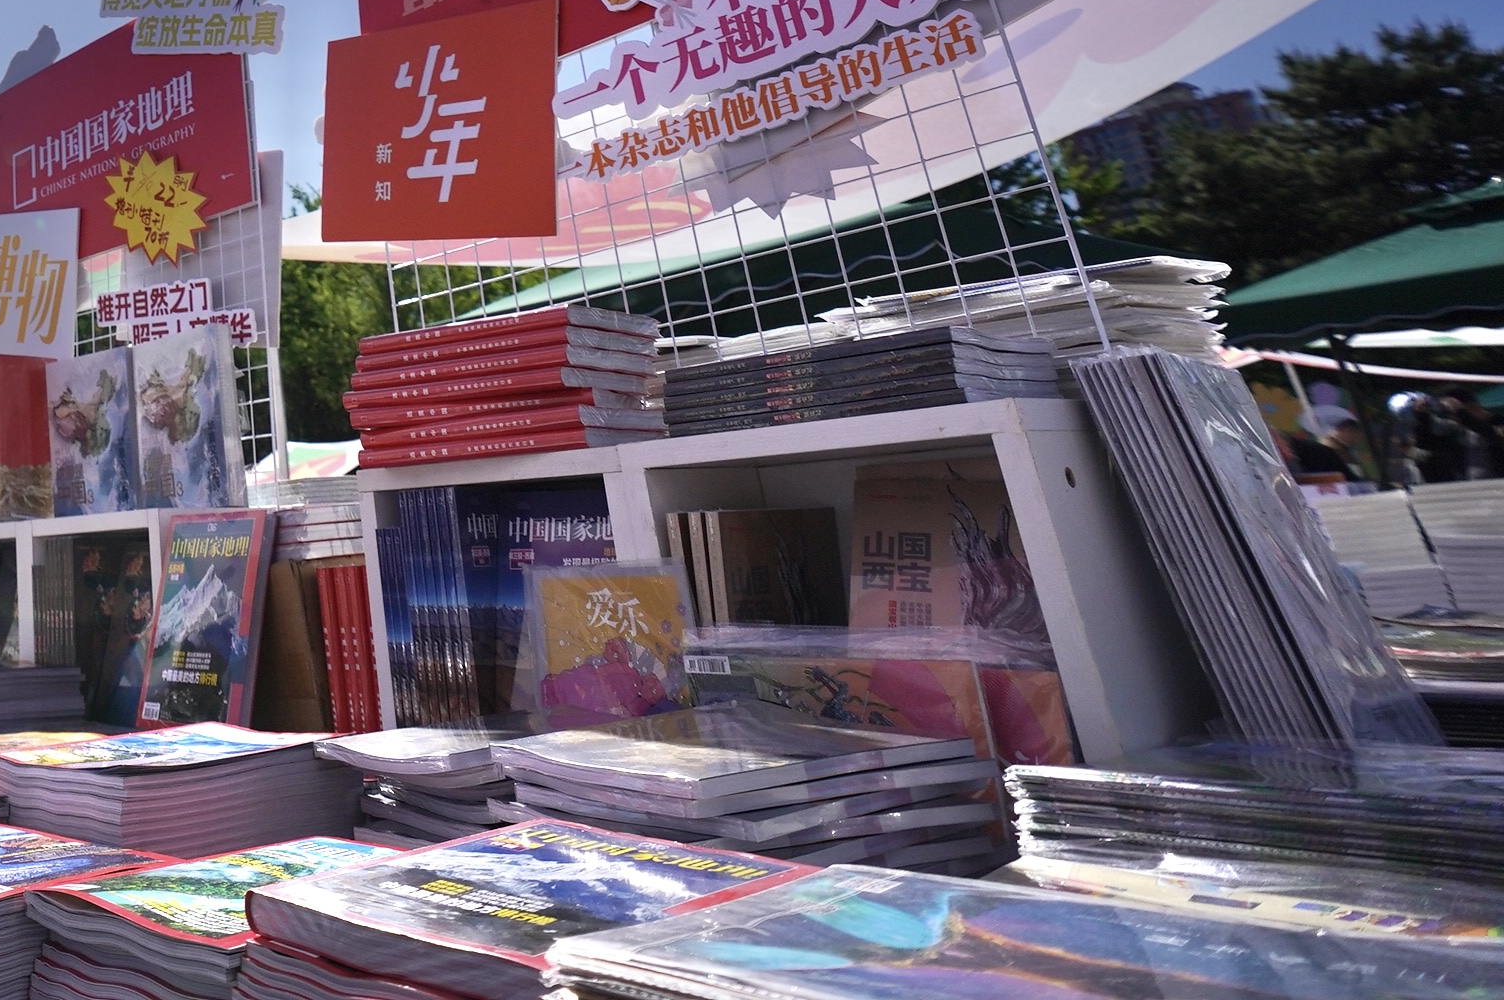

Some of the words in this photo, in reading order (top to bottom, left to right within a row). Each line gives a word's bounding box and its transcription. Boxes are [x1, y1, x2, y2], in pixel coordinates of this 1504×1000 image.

[137, 10, 277, 48] 绽放生命本真
[561, 16, 979, 180] 一本杂志和他倡导的生活
[39, 71, 194, 179] 中国国家地理
[39, 173, 76, 198] CHINESE
[375, 142, 392, 203] 新知
[98, 281, 208, 323] 推开自然之门
[171, 535, 250, 560] 中国国家地理
[584, 586, 651, 637] 爱乐
